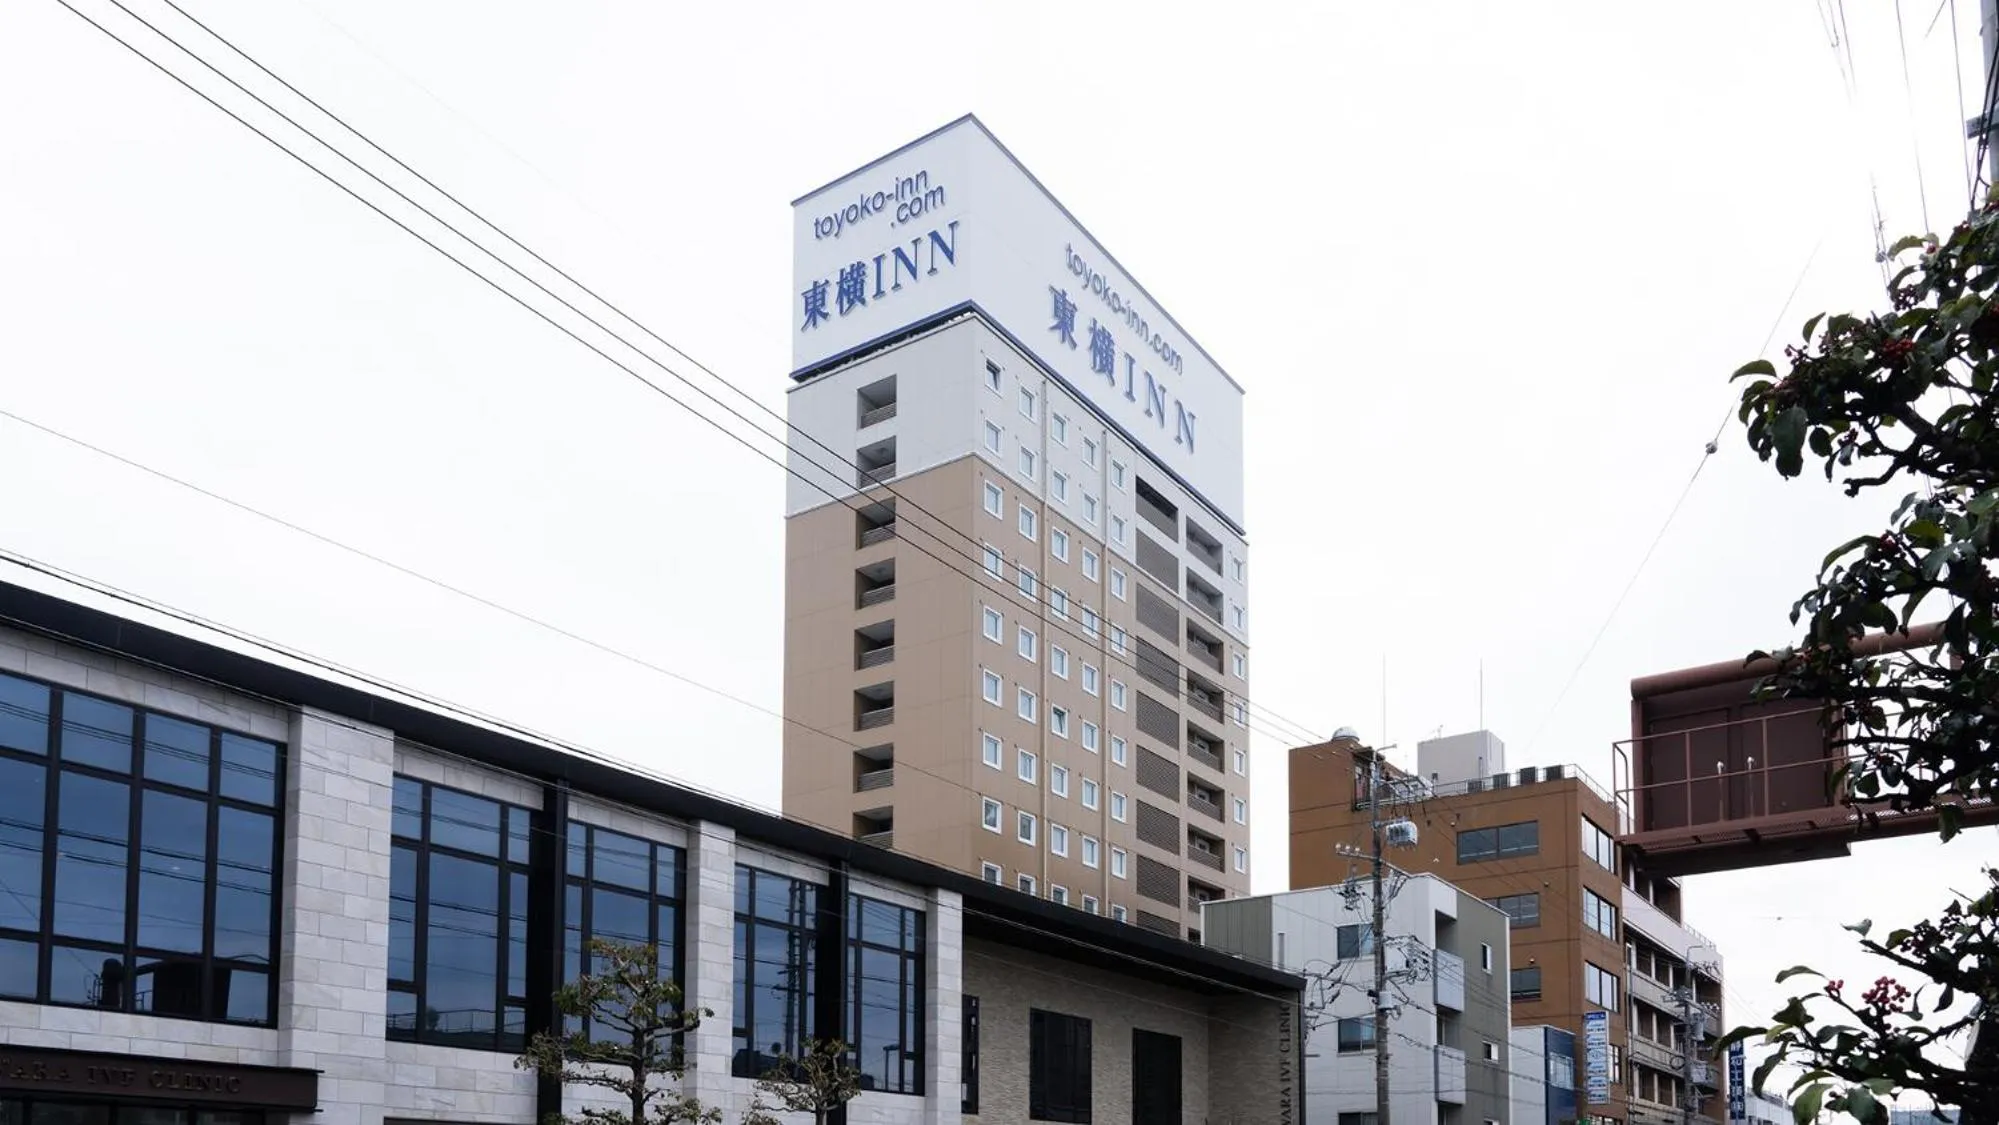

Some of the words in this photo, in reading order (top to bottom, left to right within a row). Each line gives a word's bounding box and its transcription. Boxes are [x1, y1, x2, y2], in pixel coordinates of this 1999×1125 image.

[814, 169, 929, 240] toyoko-inn
[890, 185, 946, 229] .com
[1065, 242, 1183, 376] toyoko-inn.com
[1279, 1001, 1291, 1053] CLINIC
[148, 1069, 242, 1094] CLINIC
